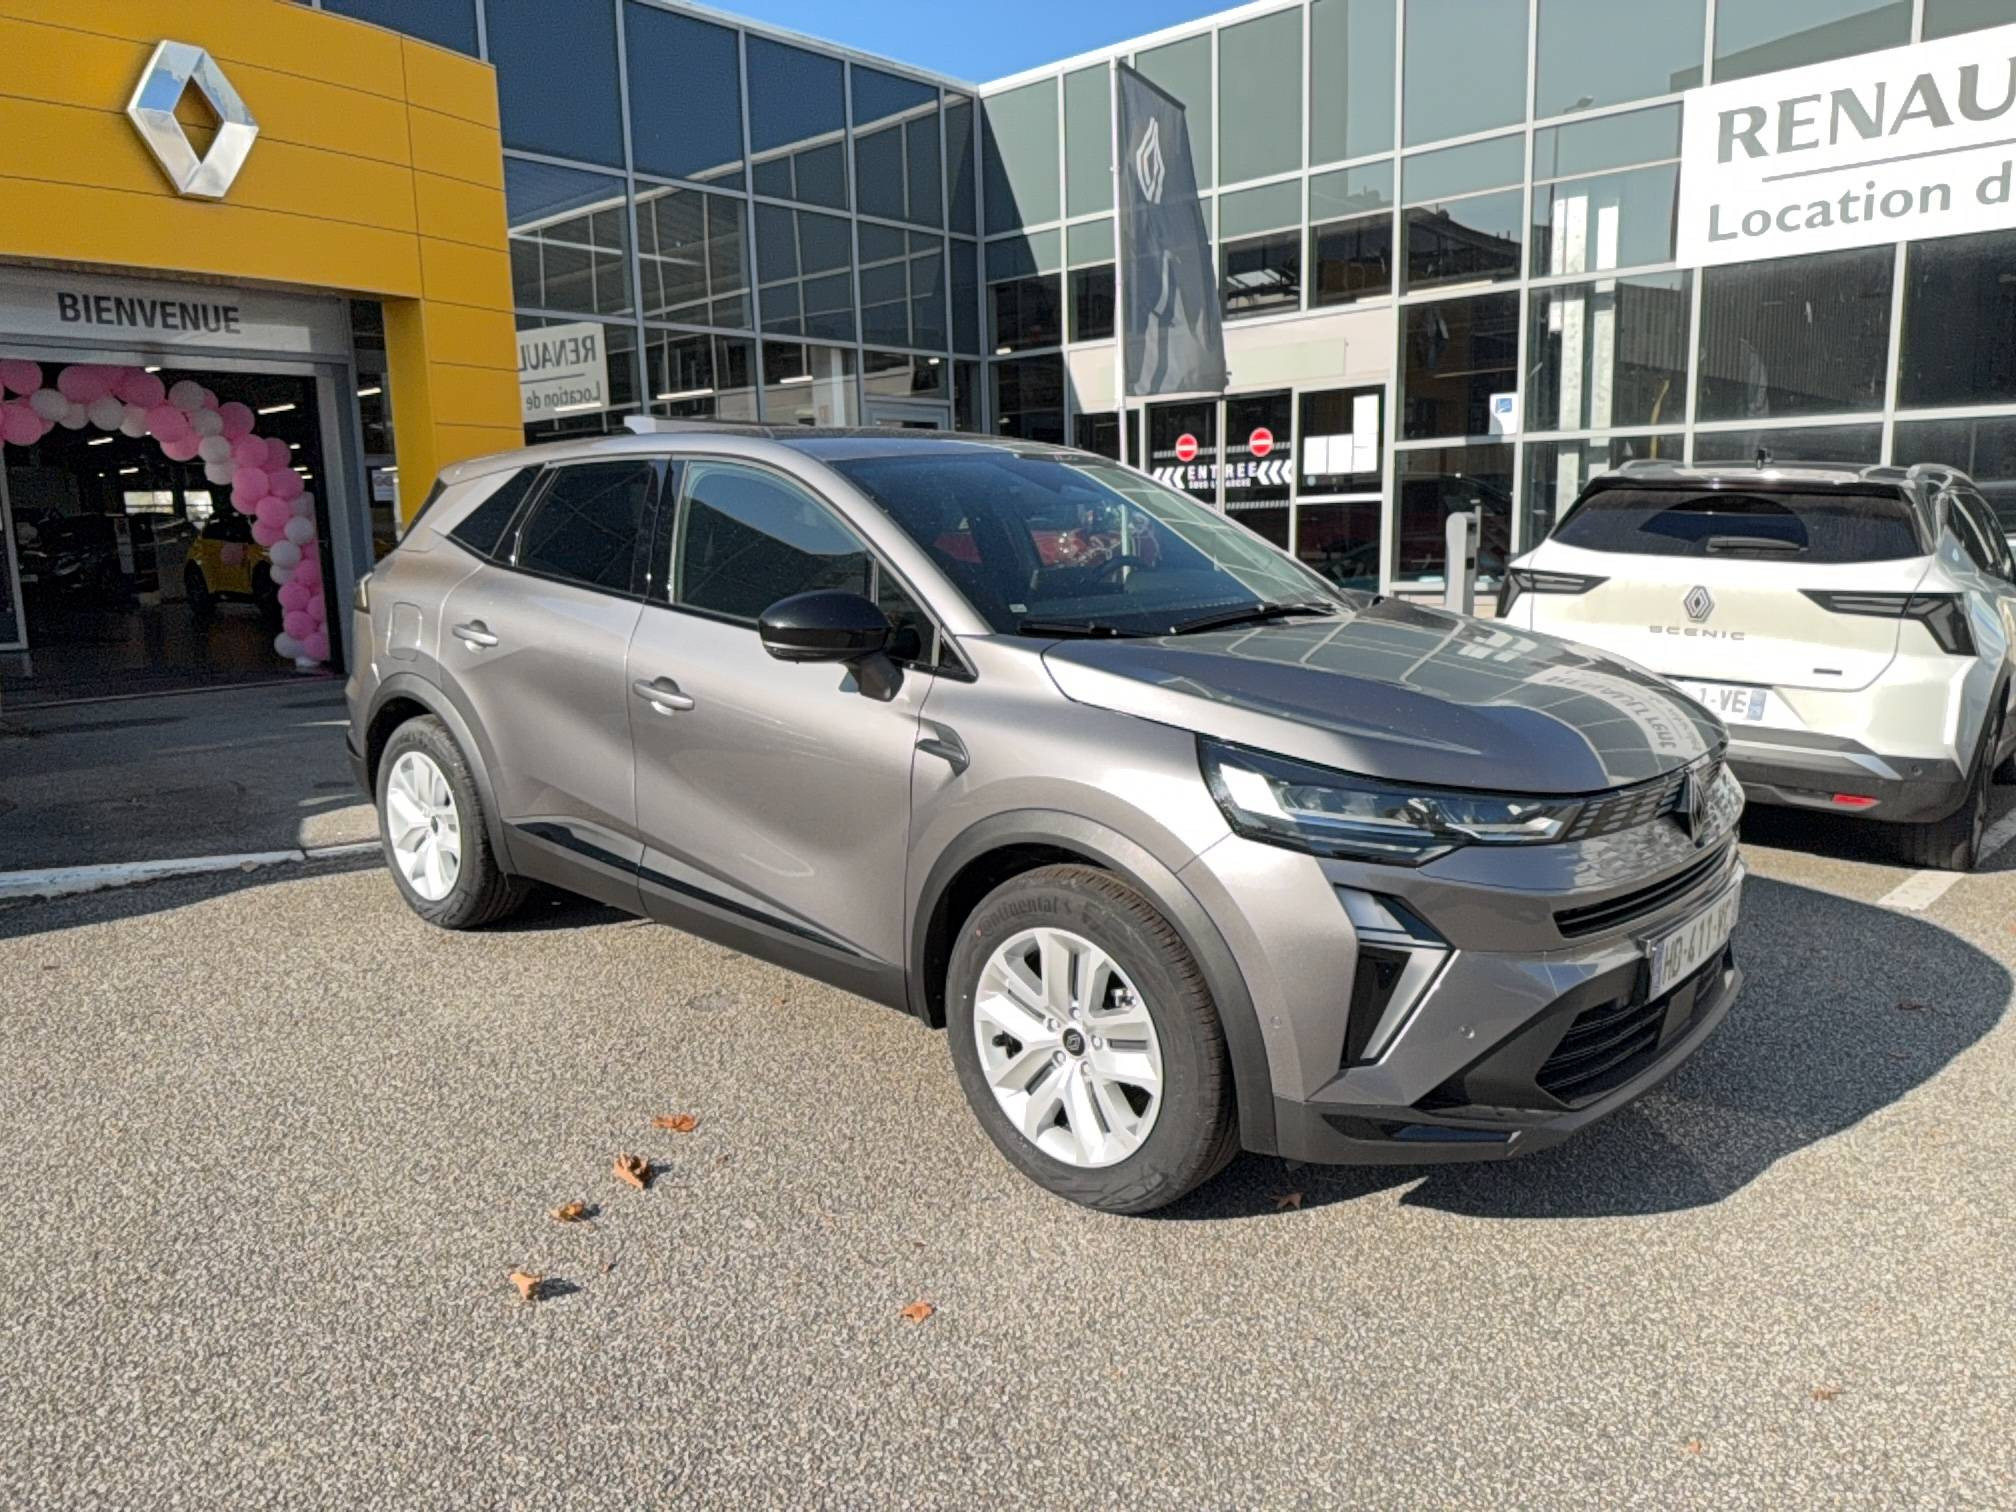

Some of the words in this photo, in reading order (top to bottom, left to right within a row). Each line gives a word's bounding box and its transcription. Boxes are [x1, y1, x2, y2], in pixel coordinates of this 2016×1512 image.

[1708, 180, 1951, 242] Location
[58, 292, 241, 334] BIENVENUE
[1649, 625, 1745, 641] SCENIC
